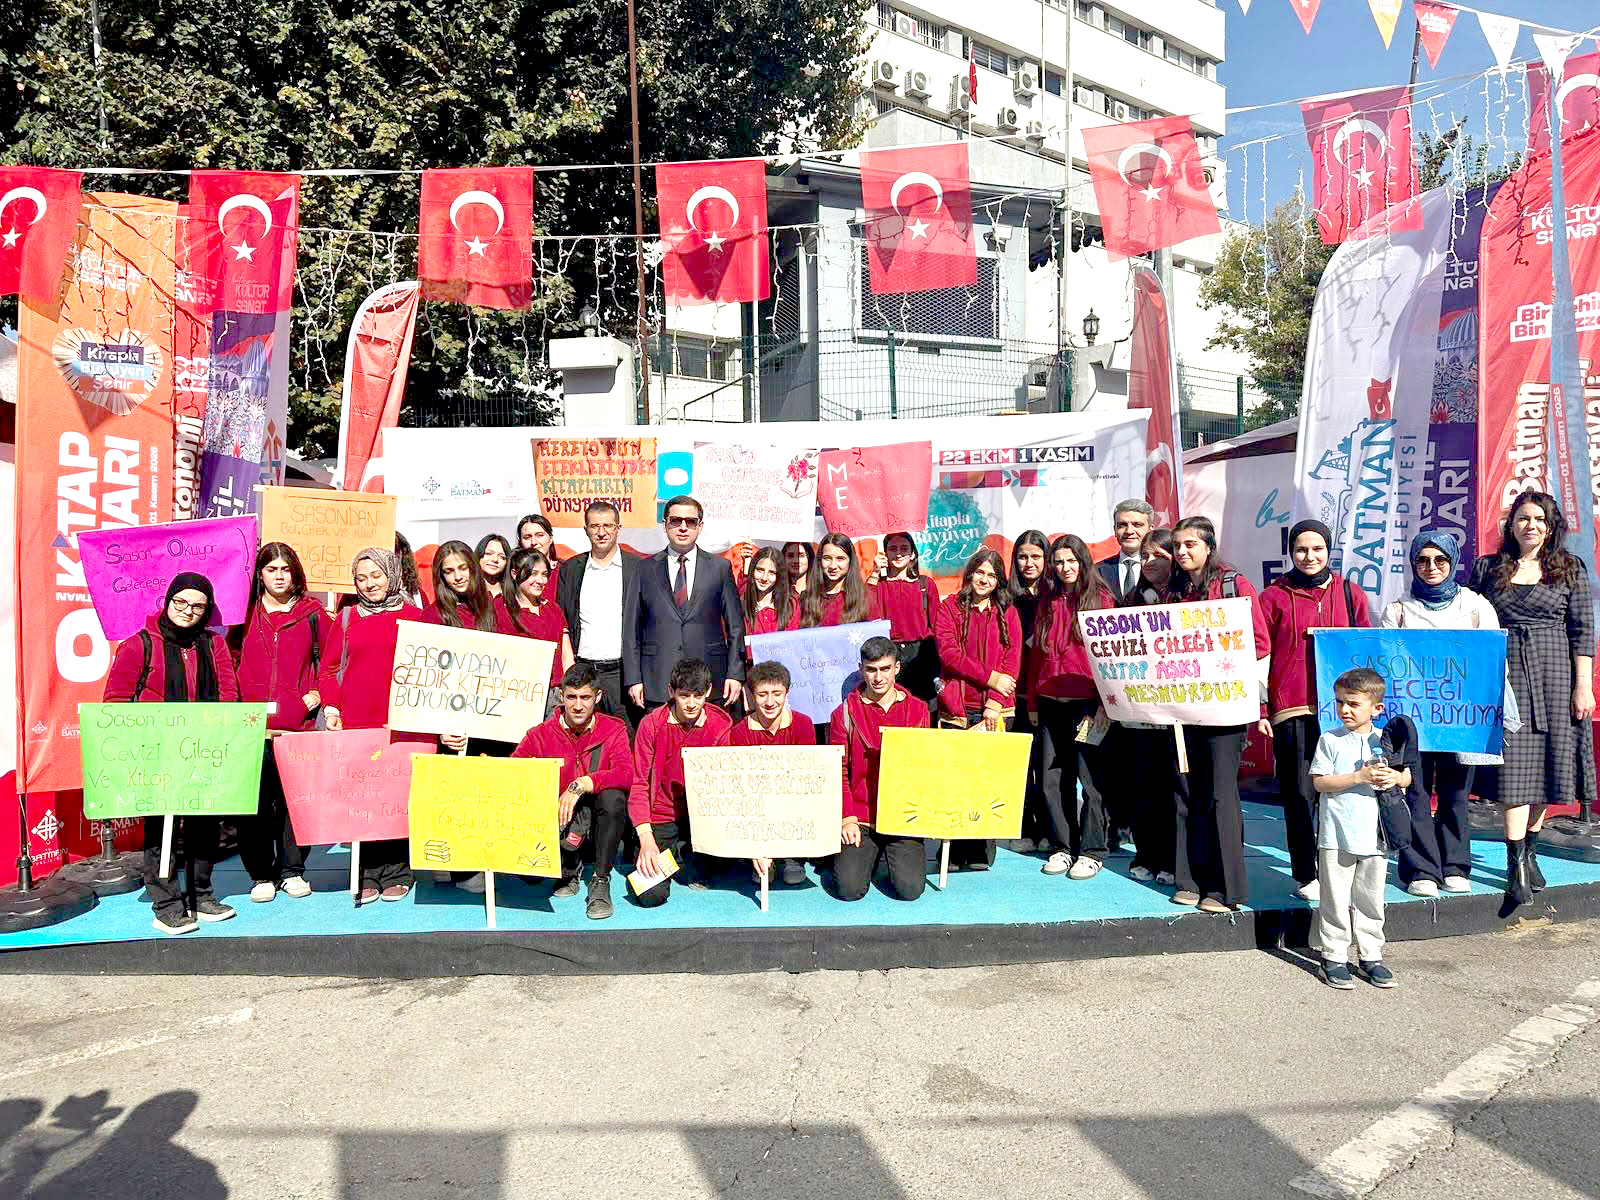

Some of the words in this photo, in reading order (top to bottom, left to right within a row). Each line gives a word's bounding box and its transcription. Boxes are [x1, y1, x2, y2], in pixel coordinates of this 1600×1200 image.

[1514, 321, 1546, 338] Bin
[1553, 386, 1563, 417] 2026
[943, 452, 966, 464] 22
[1019, 449, 1029, 462] 1
[1032, 446, 1092, 462] KASIM
[1503, 382, 1550, 509] Batman
[1346, 417, 1398, 596] BATMAN
[1391, 435, 1417, 574] BELEDİYESİ
[925, 511, 970, 528] itapla
[1567, 514, 1577, 529] 22
[1085, 610, 1172, 637] SASON'UN
[1178, 606, 1228, 630] BALI
[1217, 628, 1246, 652] VE
[1098, 658, 1149, 681] KİTAP
[1155, 657, 1201, 682] AŞKI
[1350, 653, 1467, 681] SASON'UN
[1122, 680, 1248, 706] MEŞHURDUR
[101, 736, 161, 762] Cevizi
[179, 736, 231, 768] Çileği
[88, 768, 111, 789] Ve
[127, 766, 173, 793] Kitap
